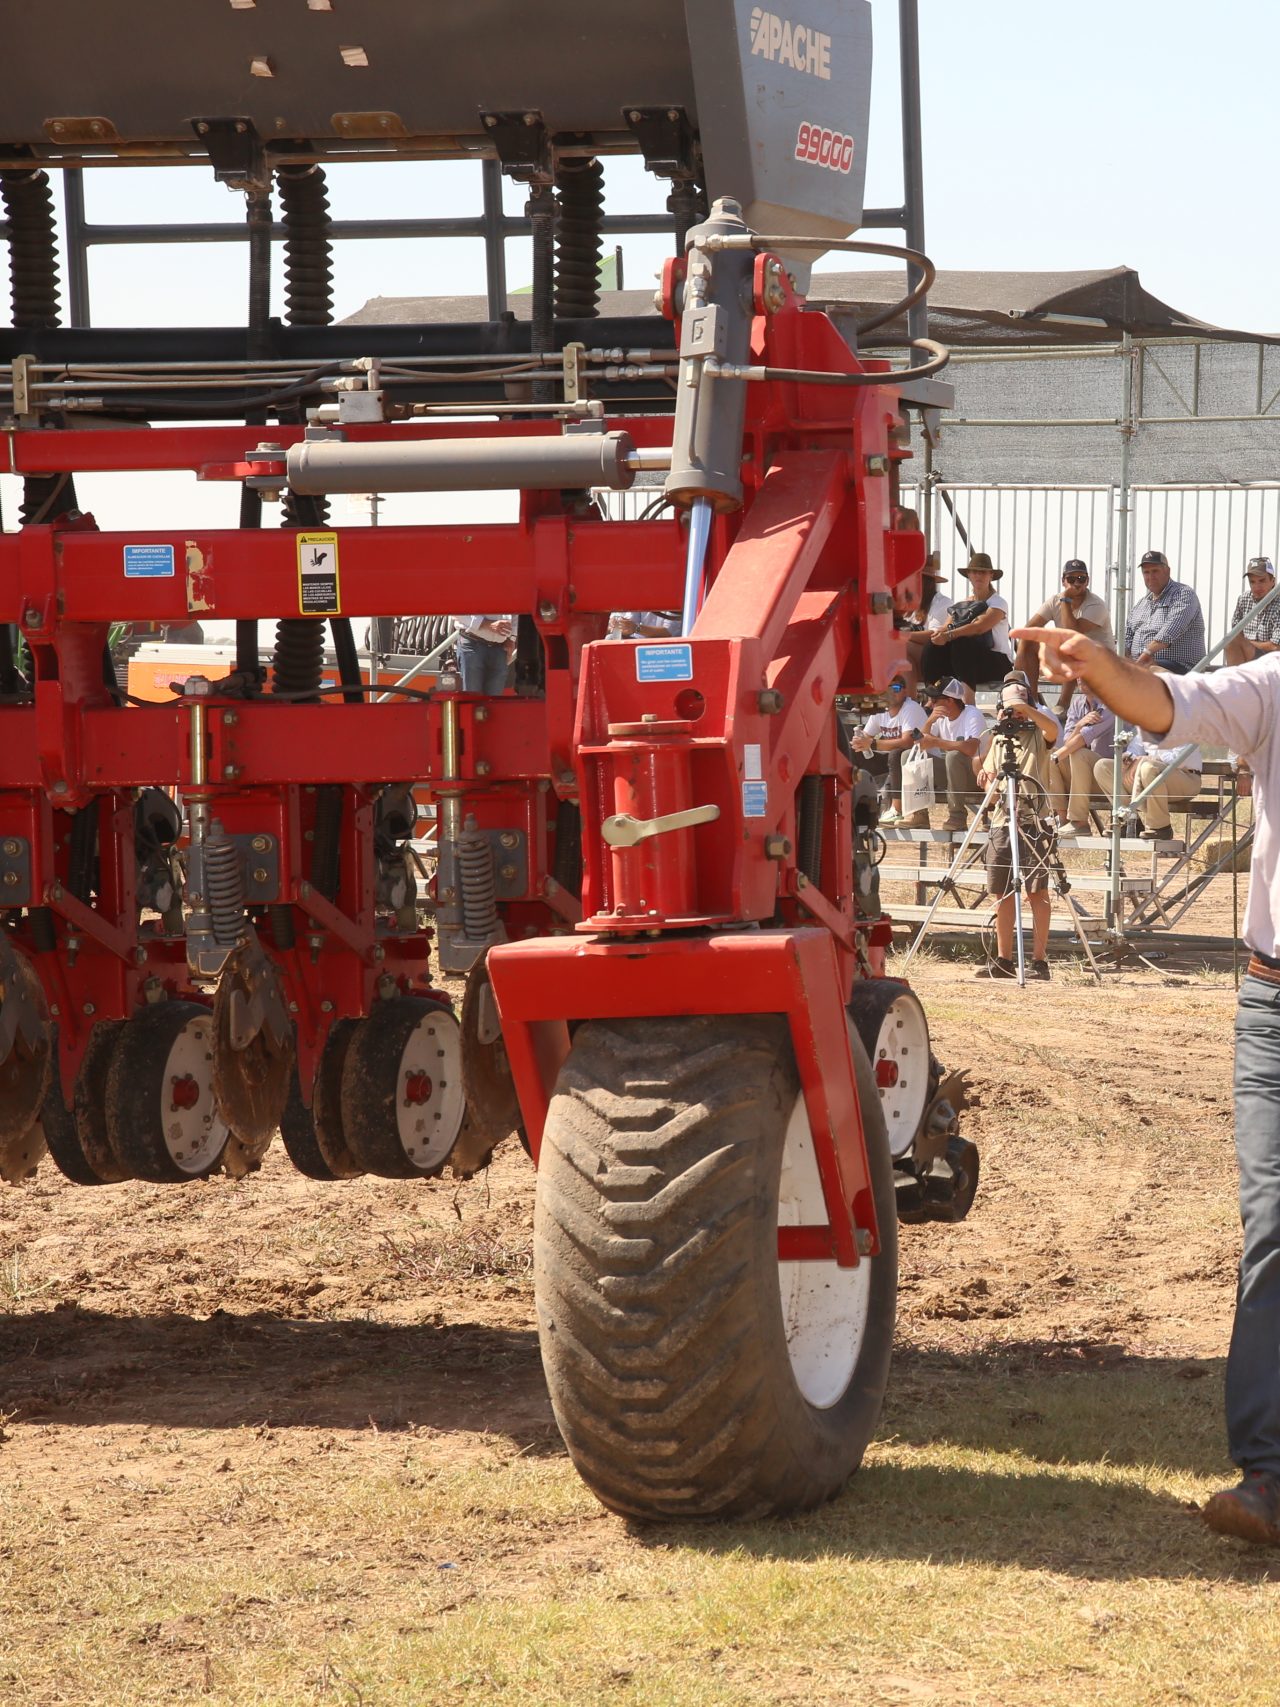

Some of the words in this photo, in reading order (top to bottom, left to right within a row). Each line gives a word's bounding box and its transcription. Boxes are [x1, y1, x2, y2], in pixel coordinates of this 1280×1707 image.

[751, 8, 832, 81] APACHE
[796, 122, 854, 174] 99000
[645, 648, 683, 656] IMPORTANTE
